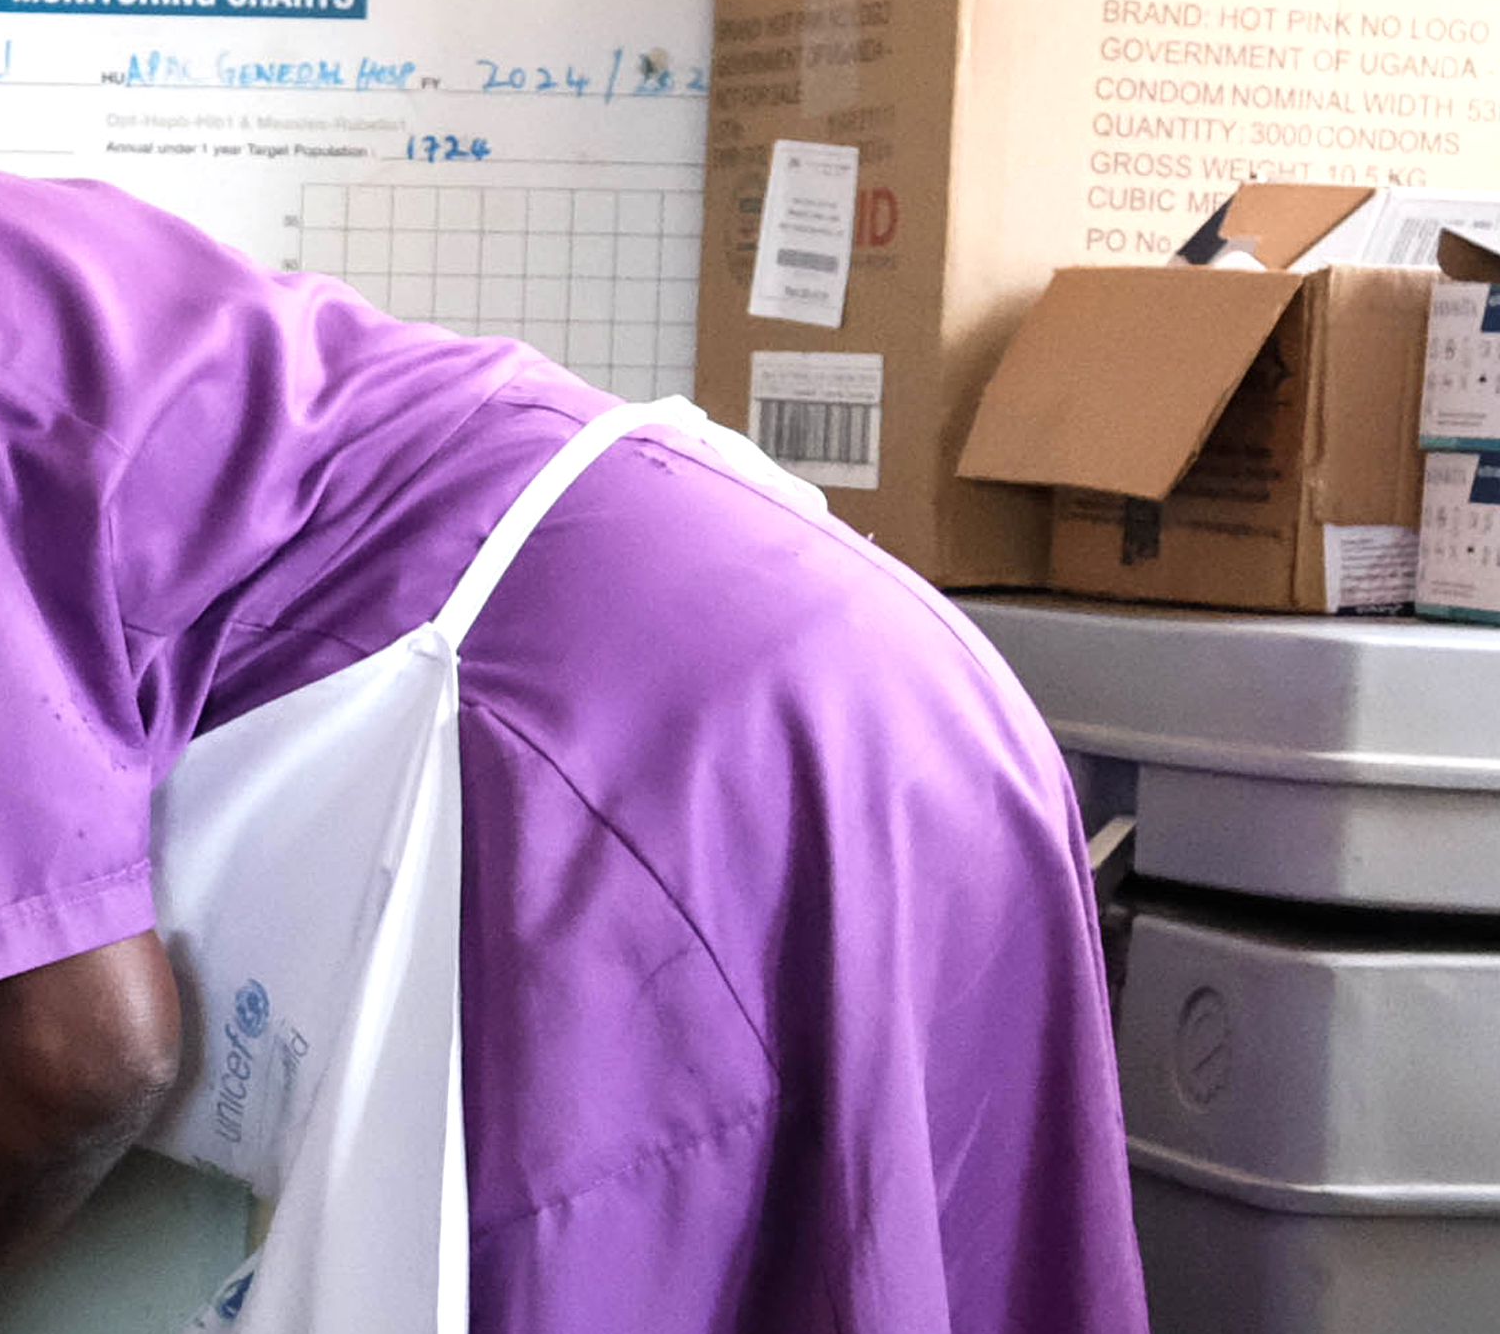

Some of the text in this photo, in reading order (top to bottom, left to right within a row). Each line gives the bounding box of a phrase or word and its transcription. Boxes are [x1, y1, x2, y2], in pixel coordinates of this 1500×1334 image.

[1220, 6, 1277, 32] HOT
[1288, 9, 1352, 36] PINK
[1361, 14, 1400, 38] NO
[1411, 17, 1489, 44] LOGO
[1101, 37, 1477, 79] GOVERNMENT OF UGANDA
[477, 61, 591, 96] 2024
[1096, 77, 1453, 118] CONDOM NOMINAL WIDTH
[405, 136, 490, 160] 1724
[1250, 121, 1312, 146] 3000
[1317, 126, 1460, 155] CONDOMS
[1092, 151, 1191, 179] GROSS
[1088, 186, 1175, 211] CUBIC
[1087, 229, 1125, 252] PO
[215, 1023, 252, 1143] unicef
